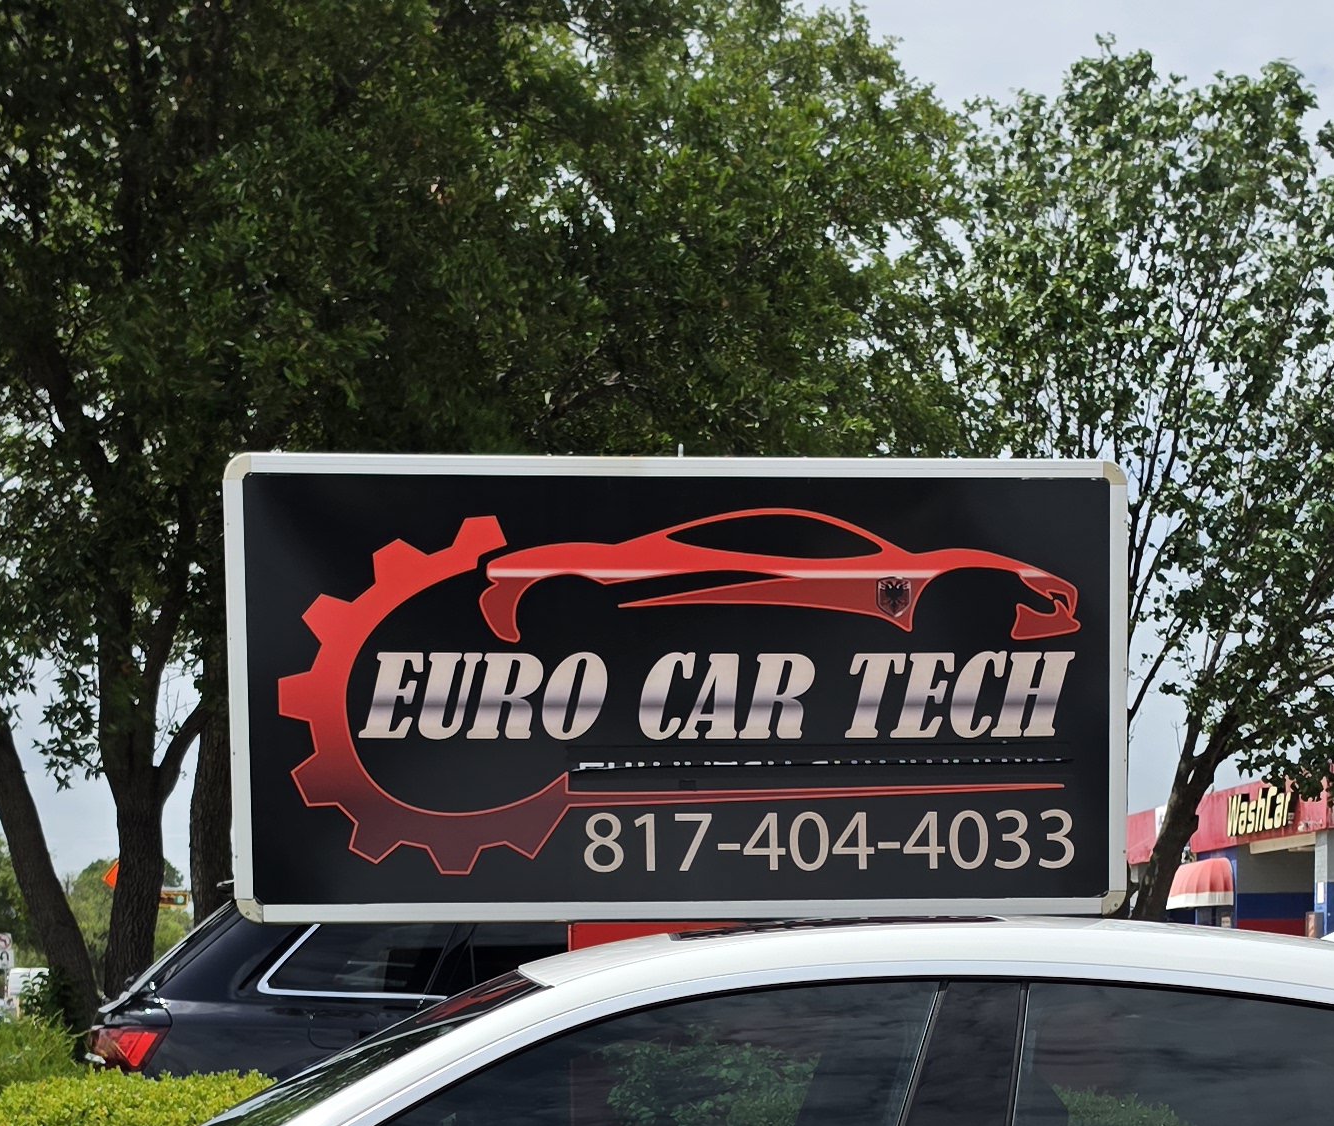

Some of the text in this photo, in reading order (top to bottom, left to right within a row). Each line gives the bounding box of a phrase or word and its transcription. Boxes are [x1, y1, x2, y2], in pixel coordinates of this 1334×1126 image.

[358, 650, 1076, 740] EURO CAR TECH
[583, 808, 1075, 873] 817-404-4033
